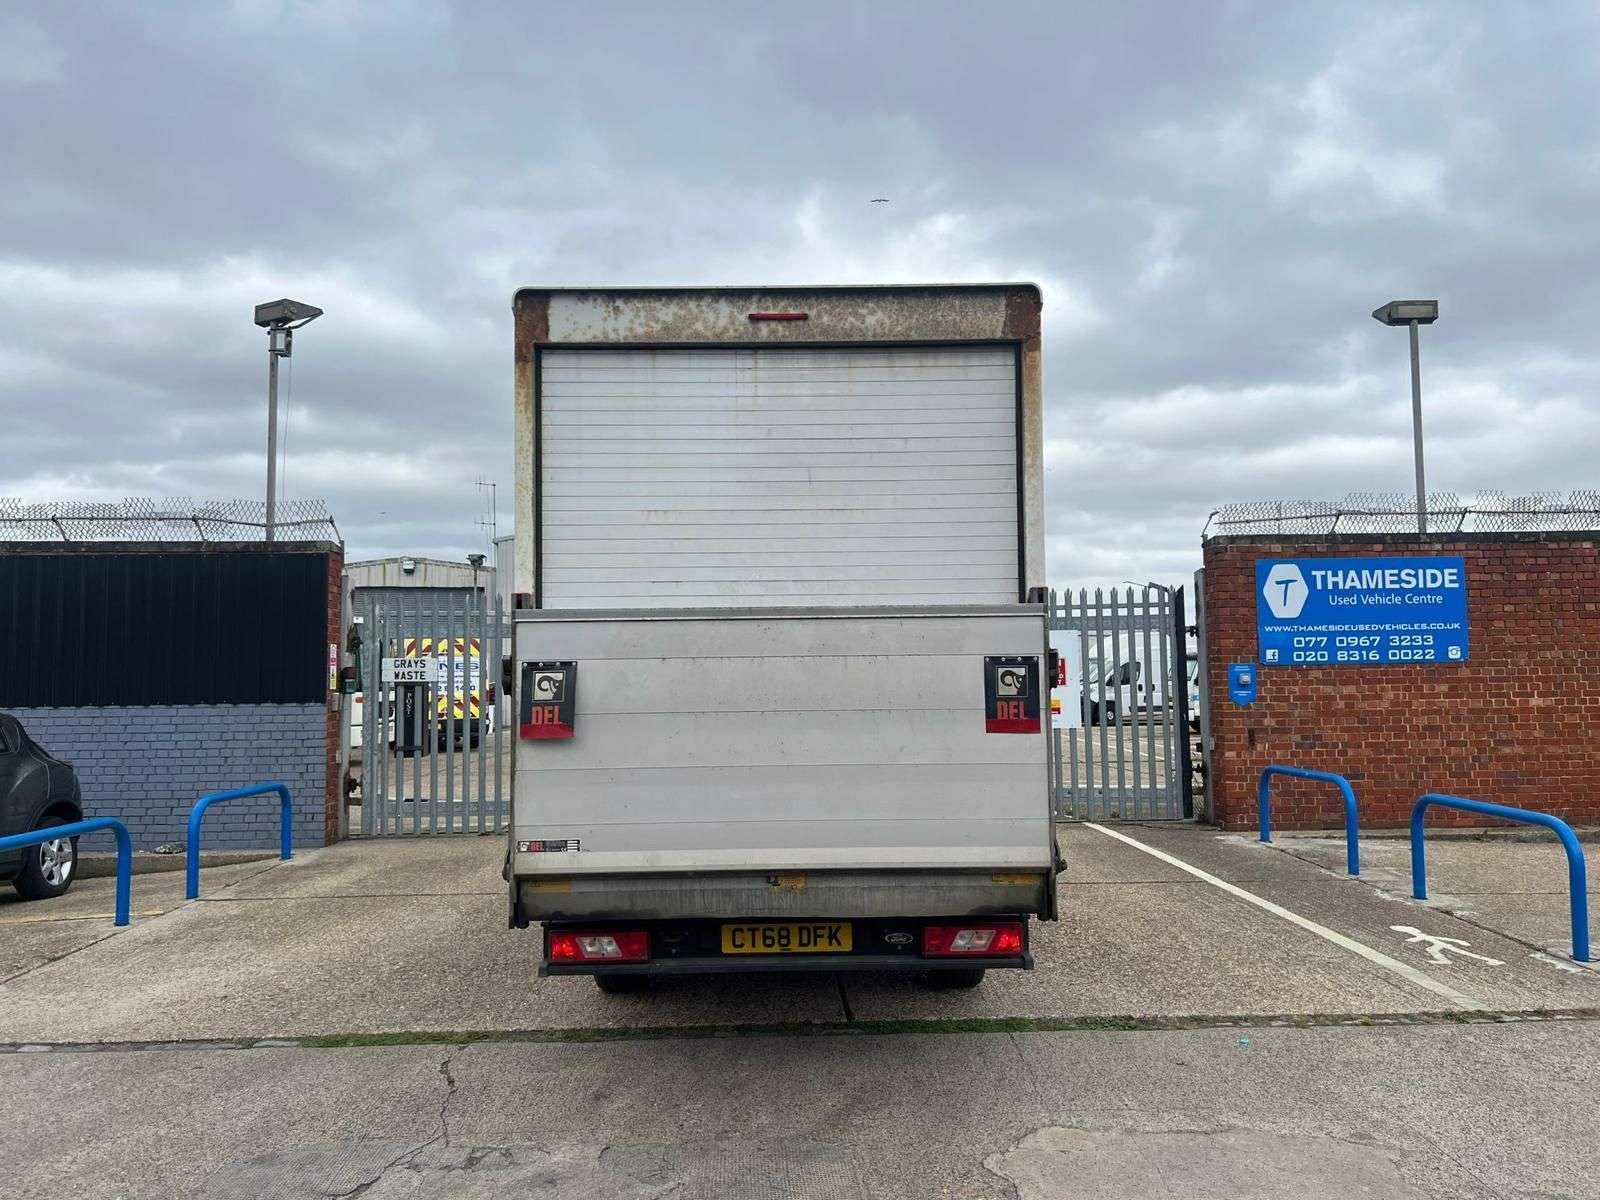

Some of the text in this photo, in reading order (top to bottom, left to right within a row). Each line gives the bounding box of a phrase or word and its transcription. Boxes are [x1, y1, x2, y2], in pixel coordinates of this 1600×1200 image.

[1312, 568, 1460, 590] THAMESIDE
[1328, 593, 1443, 606] Used Vehicle Centre
[1293, 635, 1434, 647] 077 0967 3233
[1293, 649, 1435, 662] 020 8316 0022
[394, 659, 426, 669] GRAYS
[394, 671, 426, 680] WASTE
[531, 705, 563, 725] DEL
[997, 701, 1028, 720] DEL
[731, 926, 842, 948] CT68 DFK
